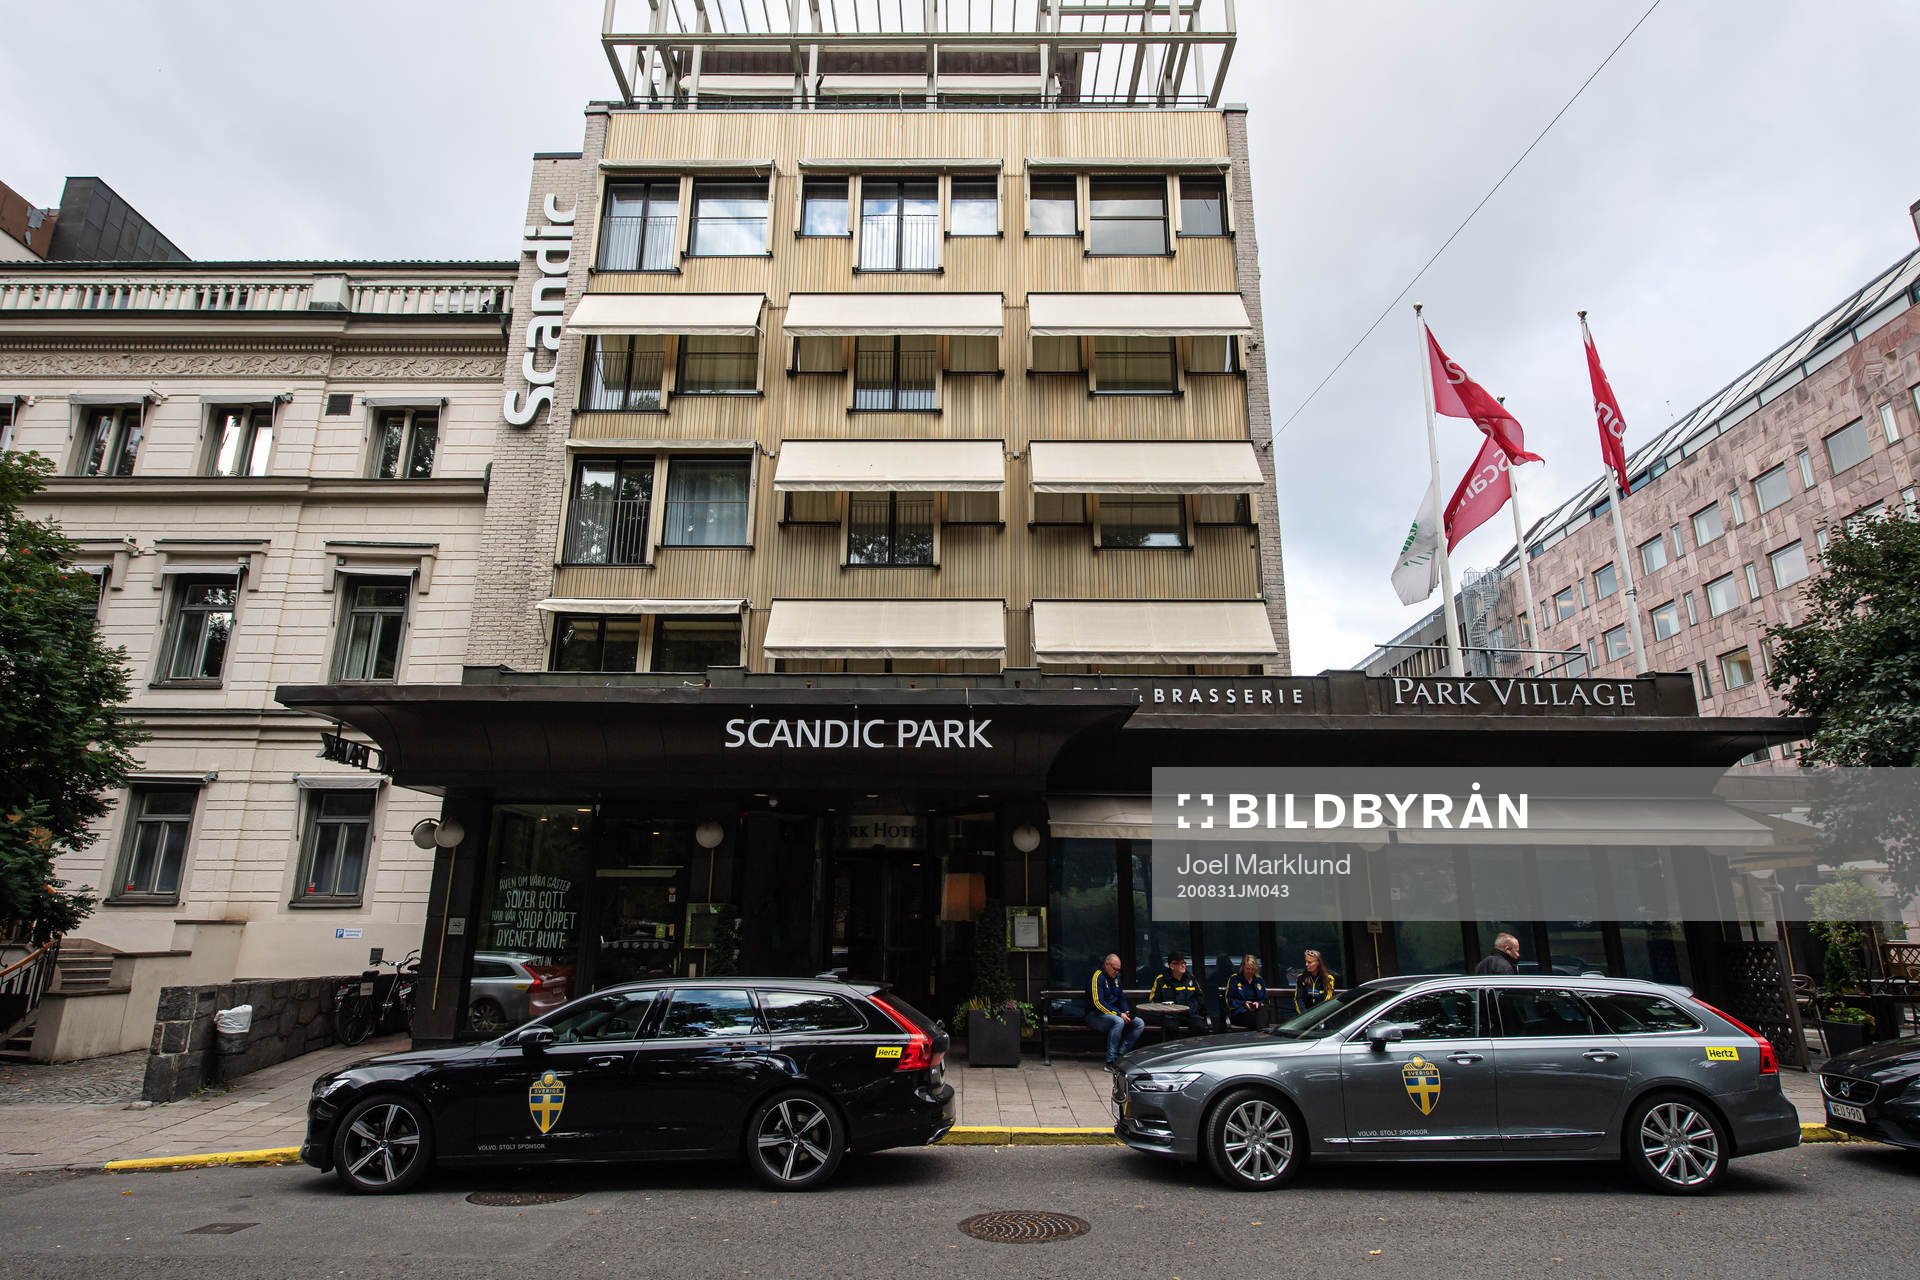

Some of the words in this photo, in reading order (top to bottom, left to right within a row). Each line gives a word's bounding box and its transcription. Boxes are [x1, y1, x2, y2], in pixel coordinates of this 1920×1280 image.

[503, 192, 577, 427] Scandic
[1153, 688, 1303, 704] BRASSERIE
[1392, 677, 1481, 705] PARK
[1487, 678, 1637, 706] VILLAGE
[724, 718, 885, 748] SCANDIC
[897, 719, 993, 748] PARK
[516, 910, 544, 929] SHOP
[496, 929, 536, 948] DYGNET
[1708, 1049, 1735, 1058] Hertz
